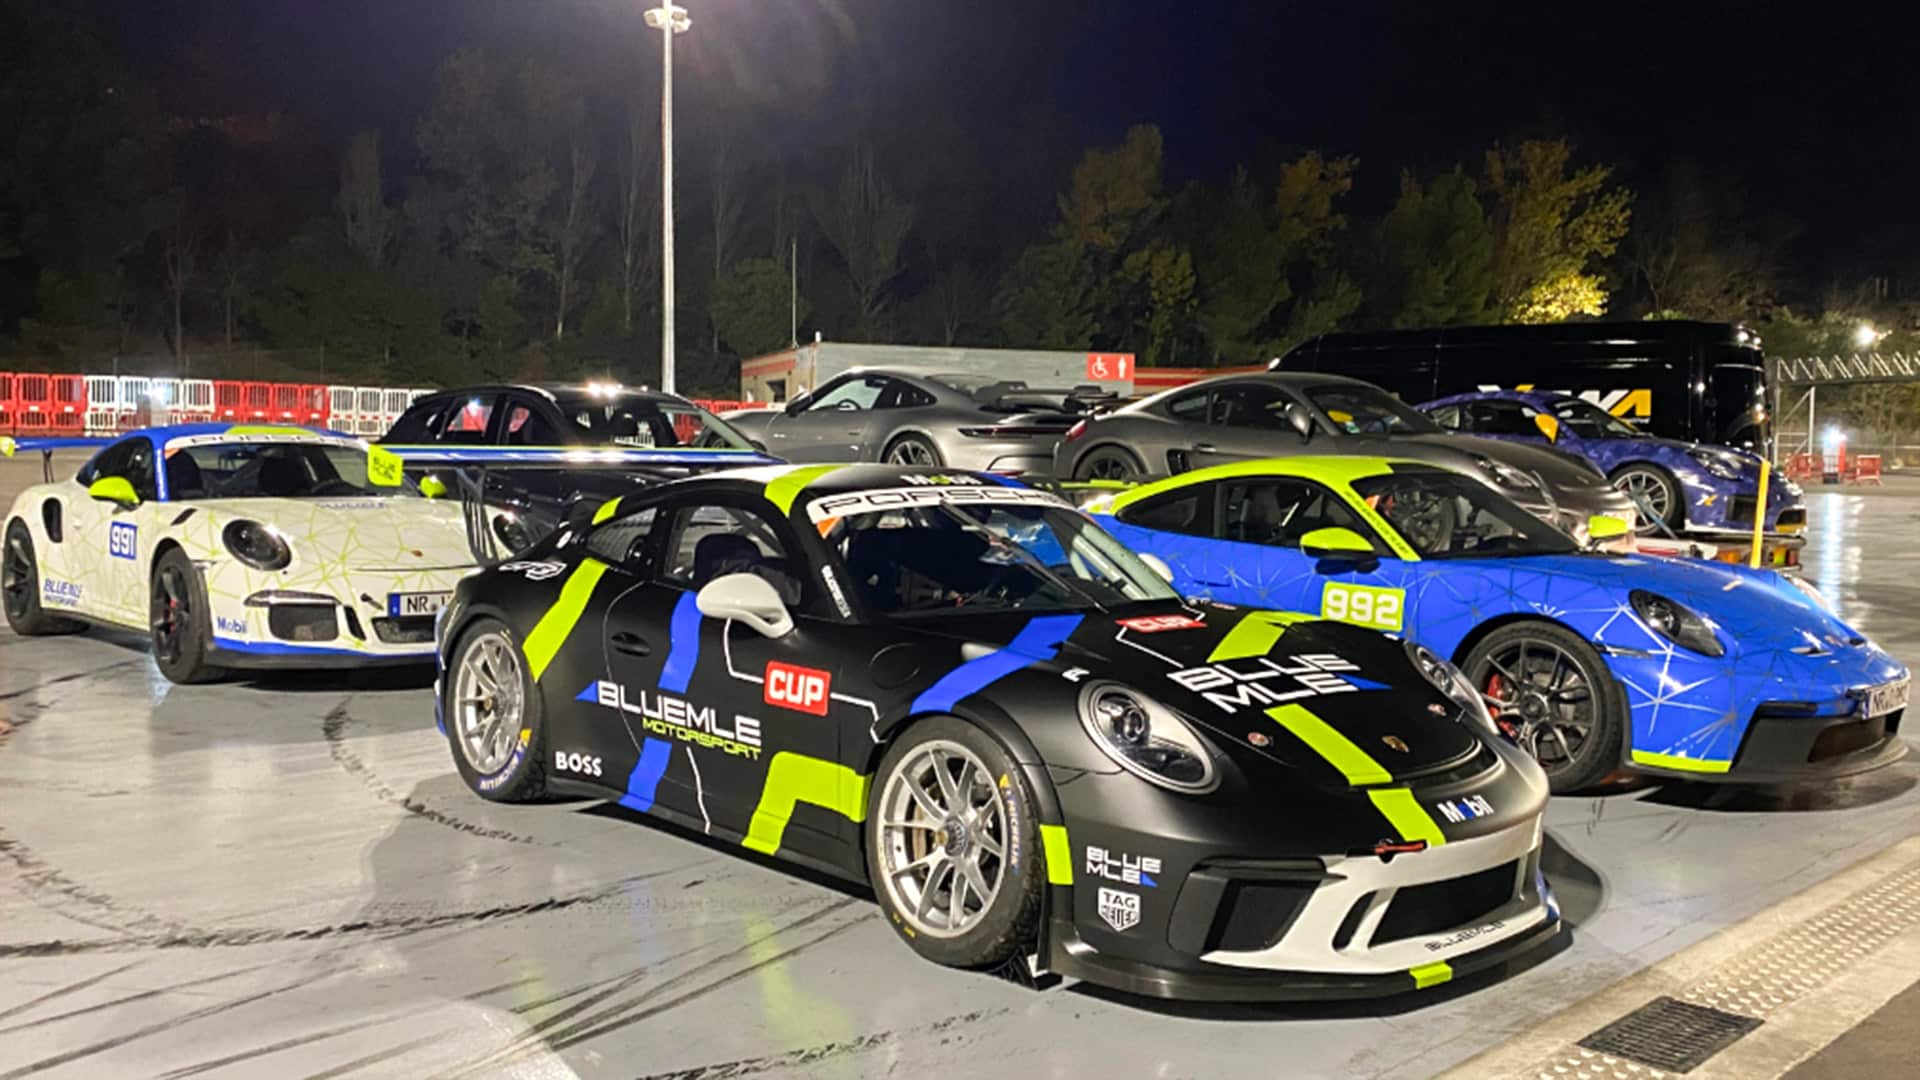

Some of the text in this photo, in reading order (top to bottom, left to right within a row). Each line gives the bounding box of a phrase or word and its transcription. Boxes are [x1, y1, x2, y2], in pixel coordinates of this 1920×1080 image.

[112, 525, 135, 556] 991
[407, 595, 428, 613] NR
[1325, 588, 1399, 627] 992
[768, 669, 824, 707] CUP
[1166, 654, 1361, 692] BLUE
[1201, 673, 1360, 714] MLE
[597, 679, 762, 747] BLUEMLE
[642, 717, 762, 761] MOTORSPORT
[555, 751, 603, 777] BOSS
[1436, 794, 1495, 824] Mobil
[1086, 845, 1162, 875] BLUE
[1086, 860, 1141, 886] MLE
[1103, 891, 1136, 909] TAG
